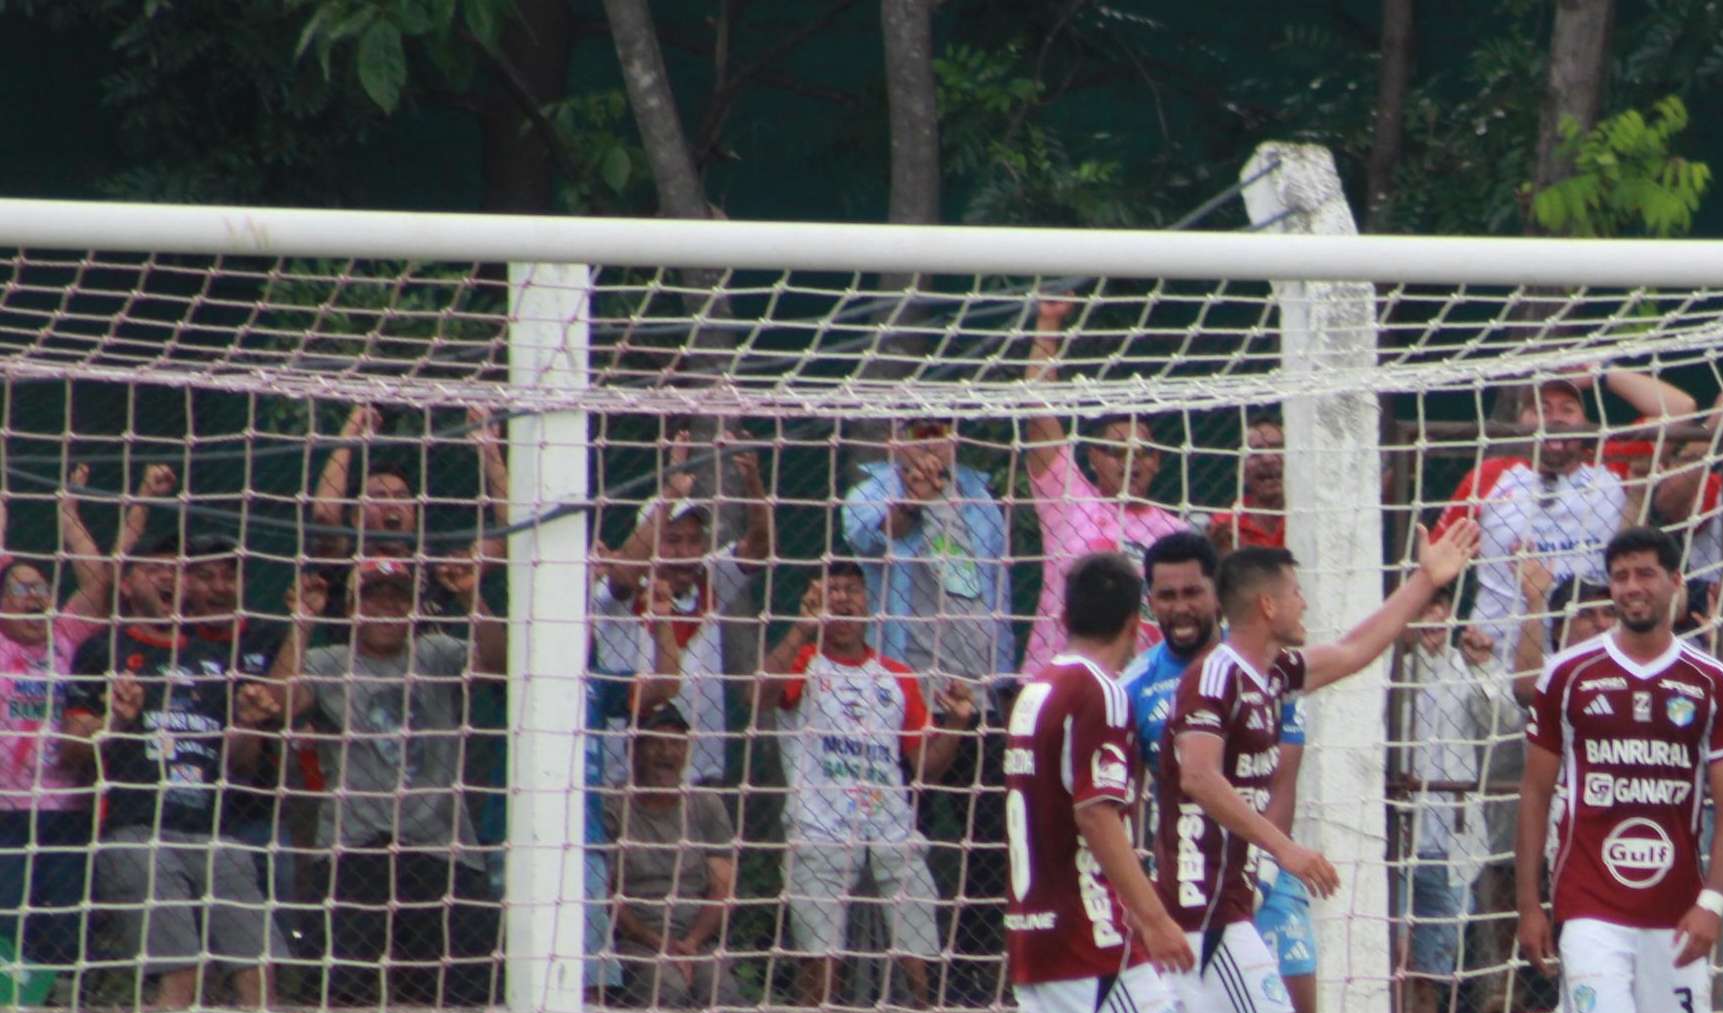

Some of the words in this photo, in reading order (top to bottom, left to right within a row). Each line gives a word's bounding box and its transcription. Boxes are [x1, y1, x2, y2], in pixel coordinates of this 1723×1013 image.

[1585, 739, 1692, 768] BANRURAL
[1177, 803, 1207, 908] PEPSI
[1610, 844, 1667, 863] Gulf
